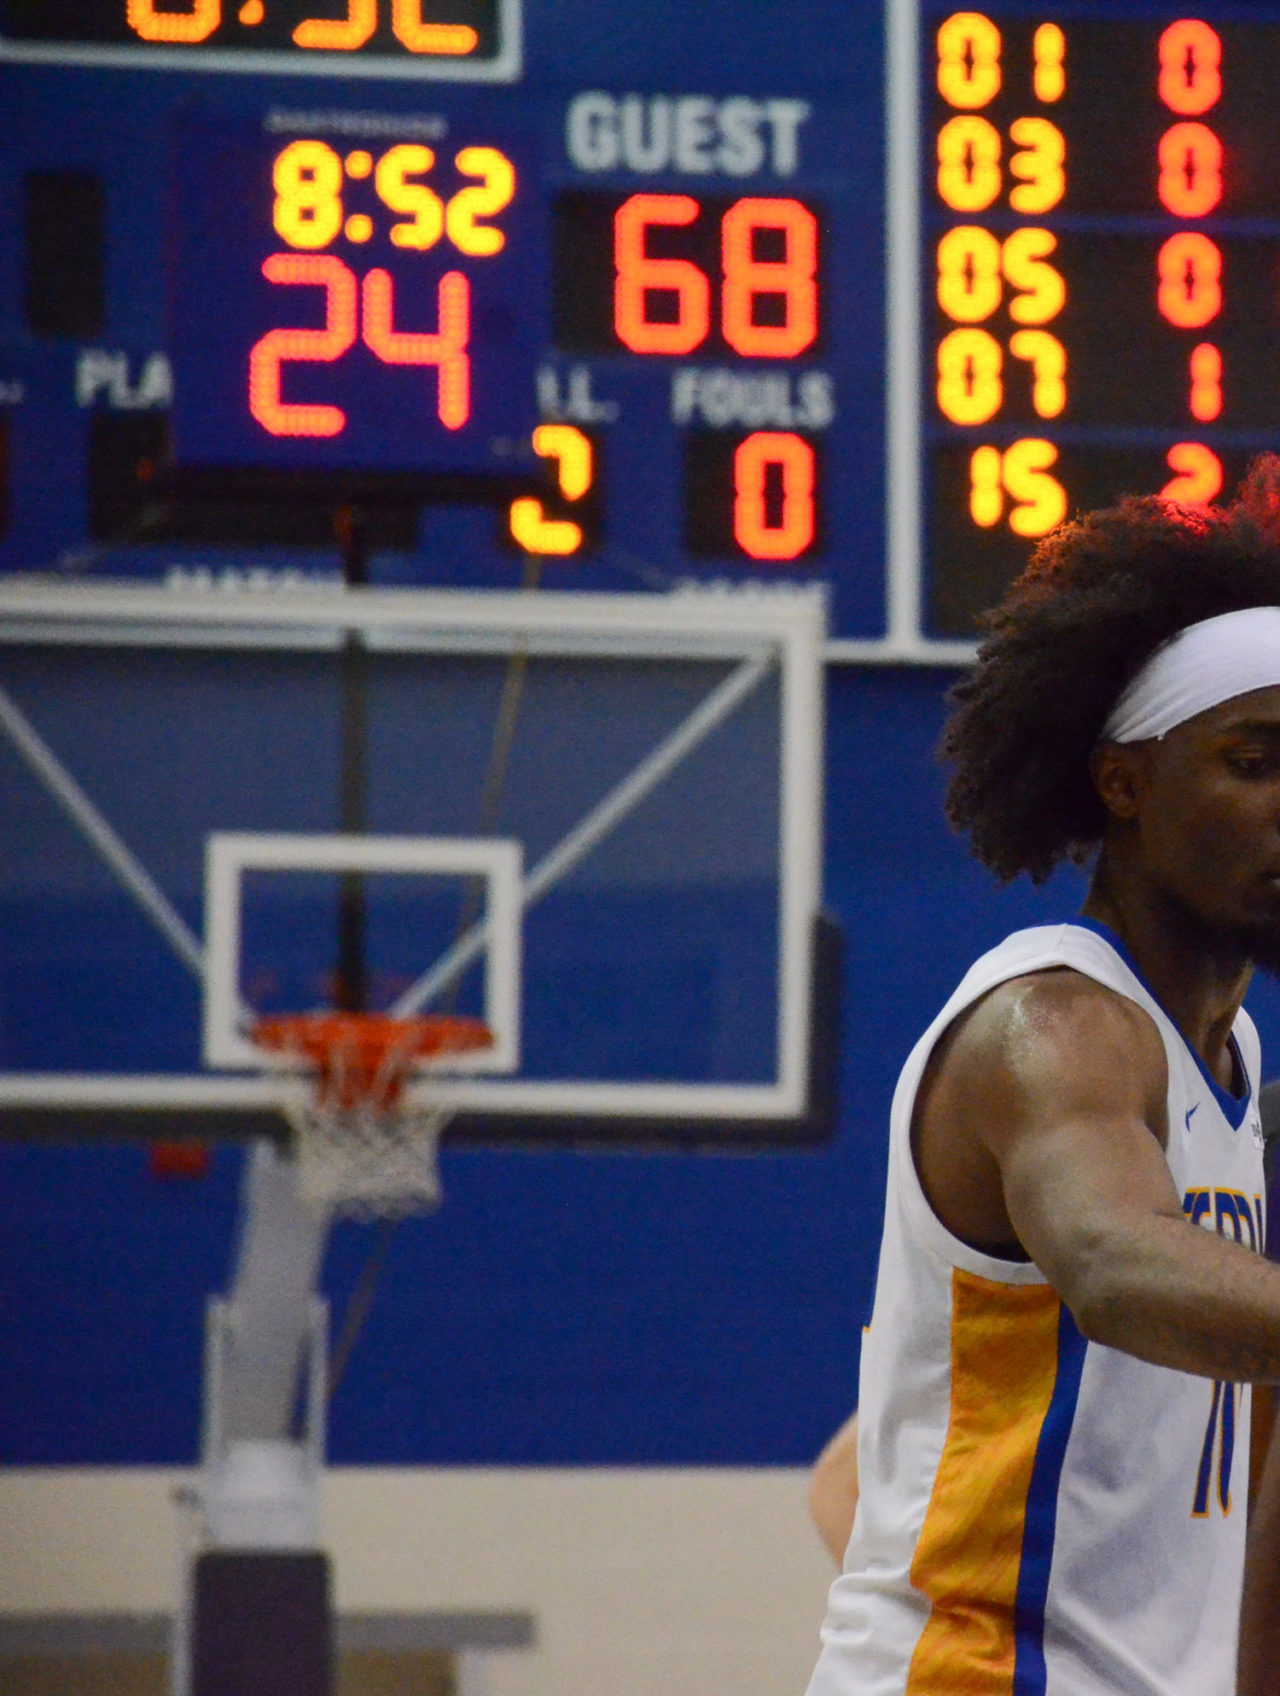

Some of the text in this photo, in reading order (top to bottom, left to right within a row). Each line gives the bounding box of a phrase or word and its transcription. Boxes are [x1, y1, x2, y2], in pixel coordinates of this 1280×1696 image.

[937, 12, 1065, 109] 01
[1158, 19, 1222, 116] 0
[566, 91, 811, 178] GUEST
[937, 115, 1066, 214] 03
[1158, 122, 1223, 218] 0
[272, 140, 515, 257] 8:52
[614, 194, 818, 358] 68
[937, 225, 1066, 325] 05
[1158, 232, 1222, 328] 0
[249, 253, 471, 437] 24
[937, 327, 1066, 426] 07
[1190, 343, 1222, 422] 1
[671, 367, 834, 428] FOULS
[734, 432, 814, 560] 0
[970, 438, 1067, 537] 15
